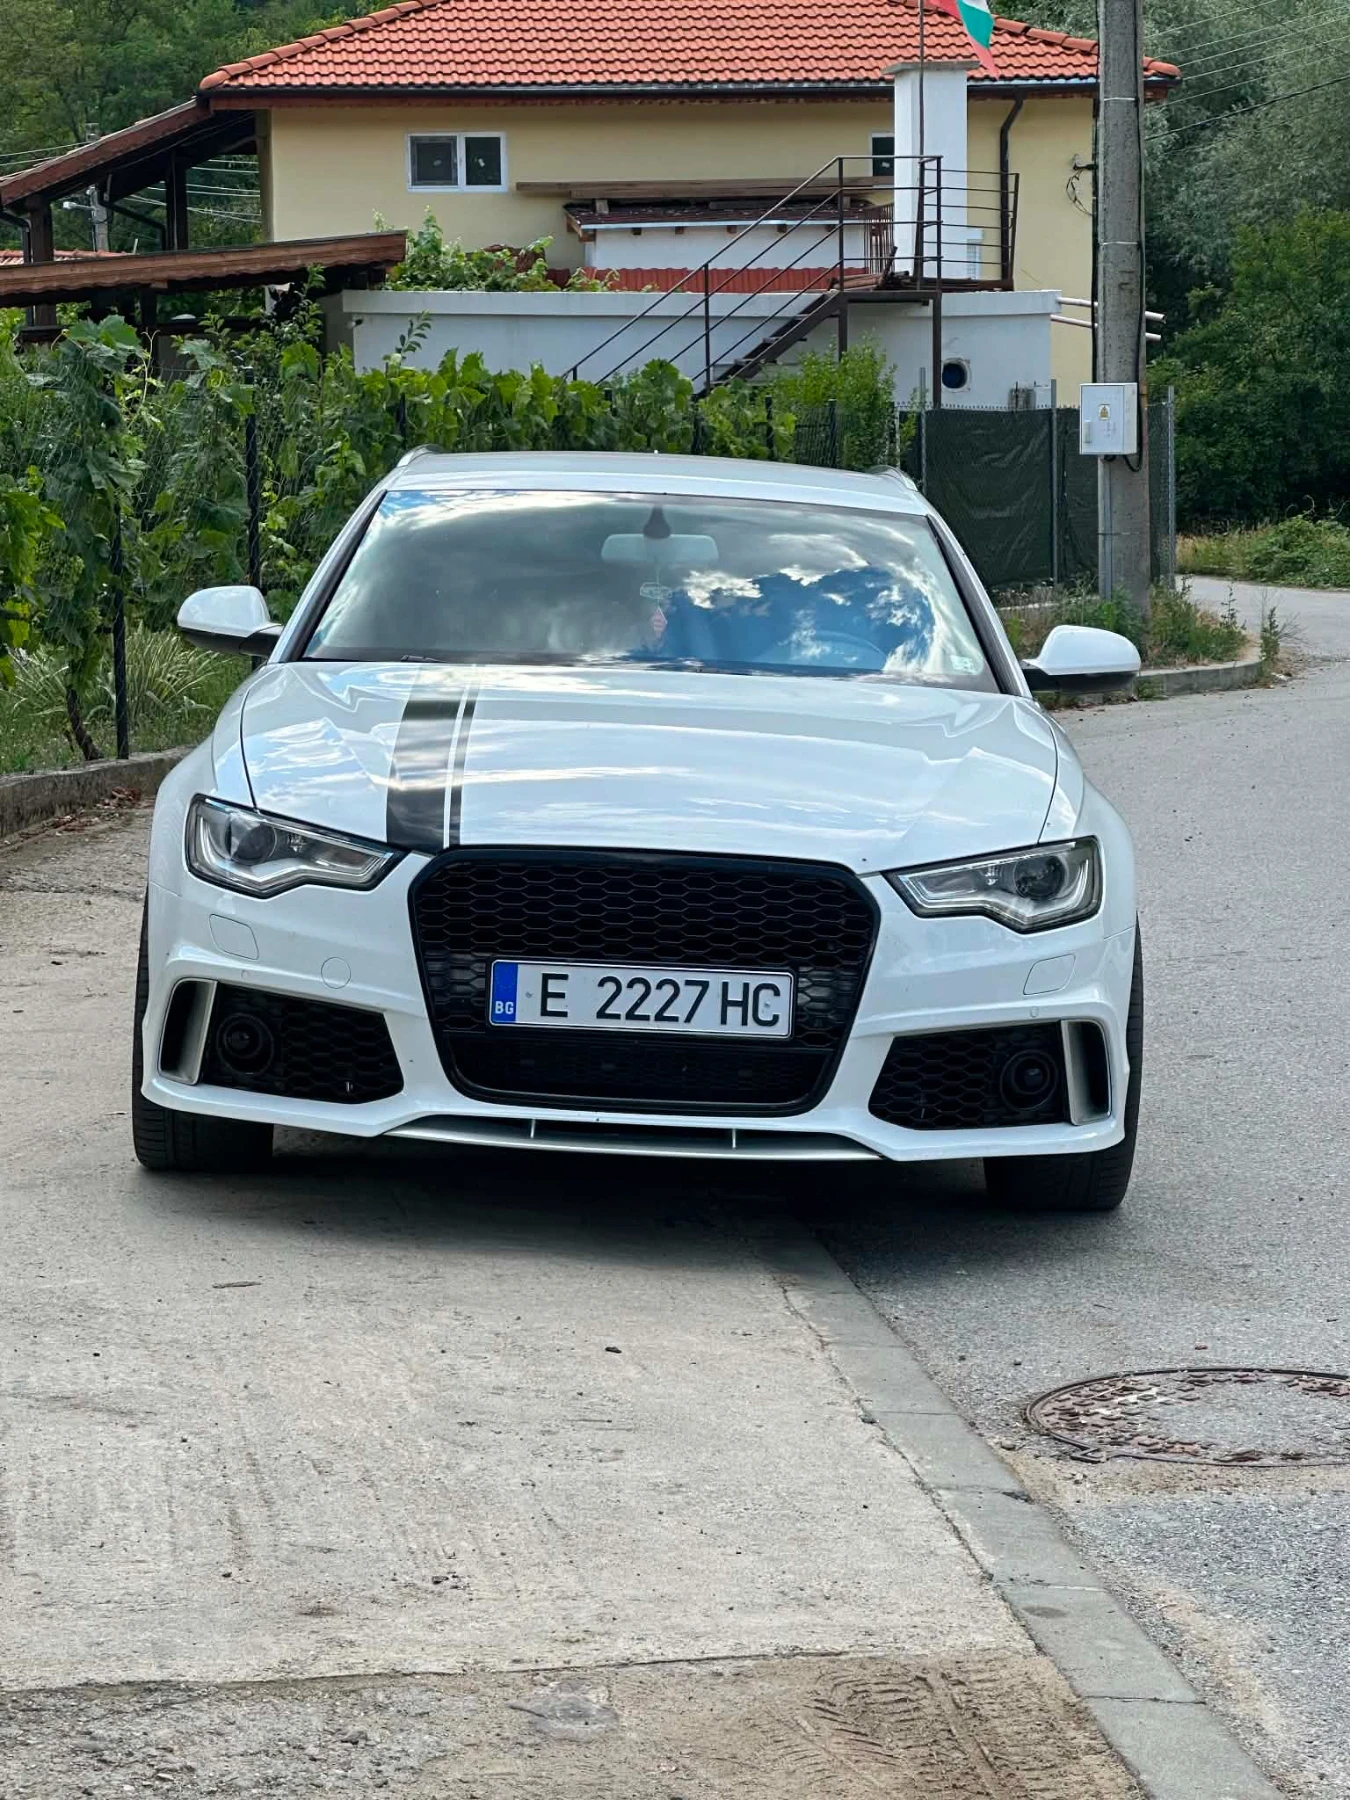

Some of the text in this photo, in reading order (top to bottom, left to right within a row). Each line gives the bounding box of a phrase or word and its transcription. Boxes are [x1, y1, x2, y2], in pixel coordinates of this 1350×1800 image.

[494, 1000, 514, 1014] BG
[540, 973, 781, 1027] E 2227 HC
